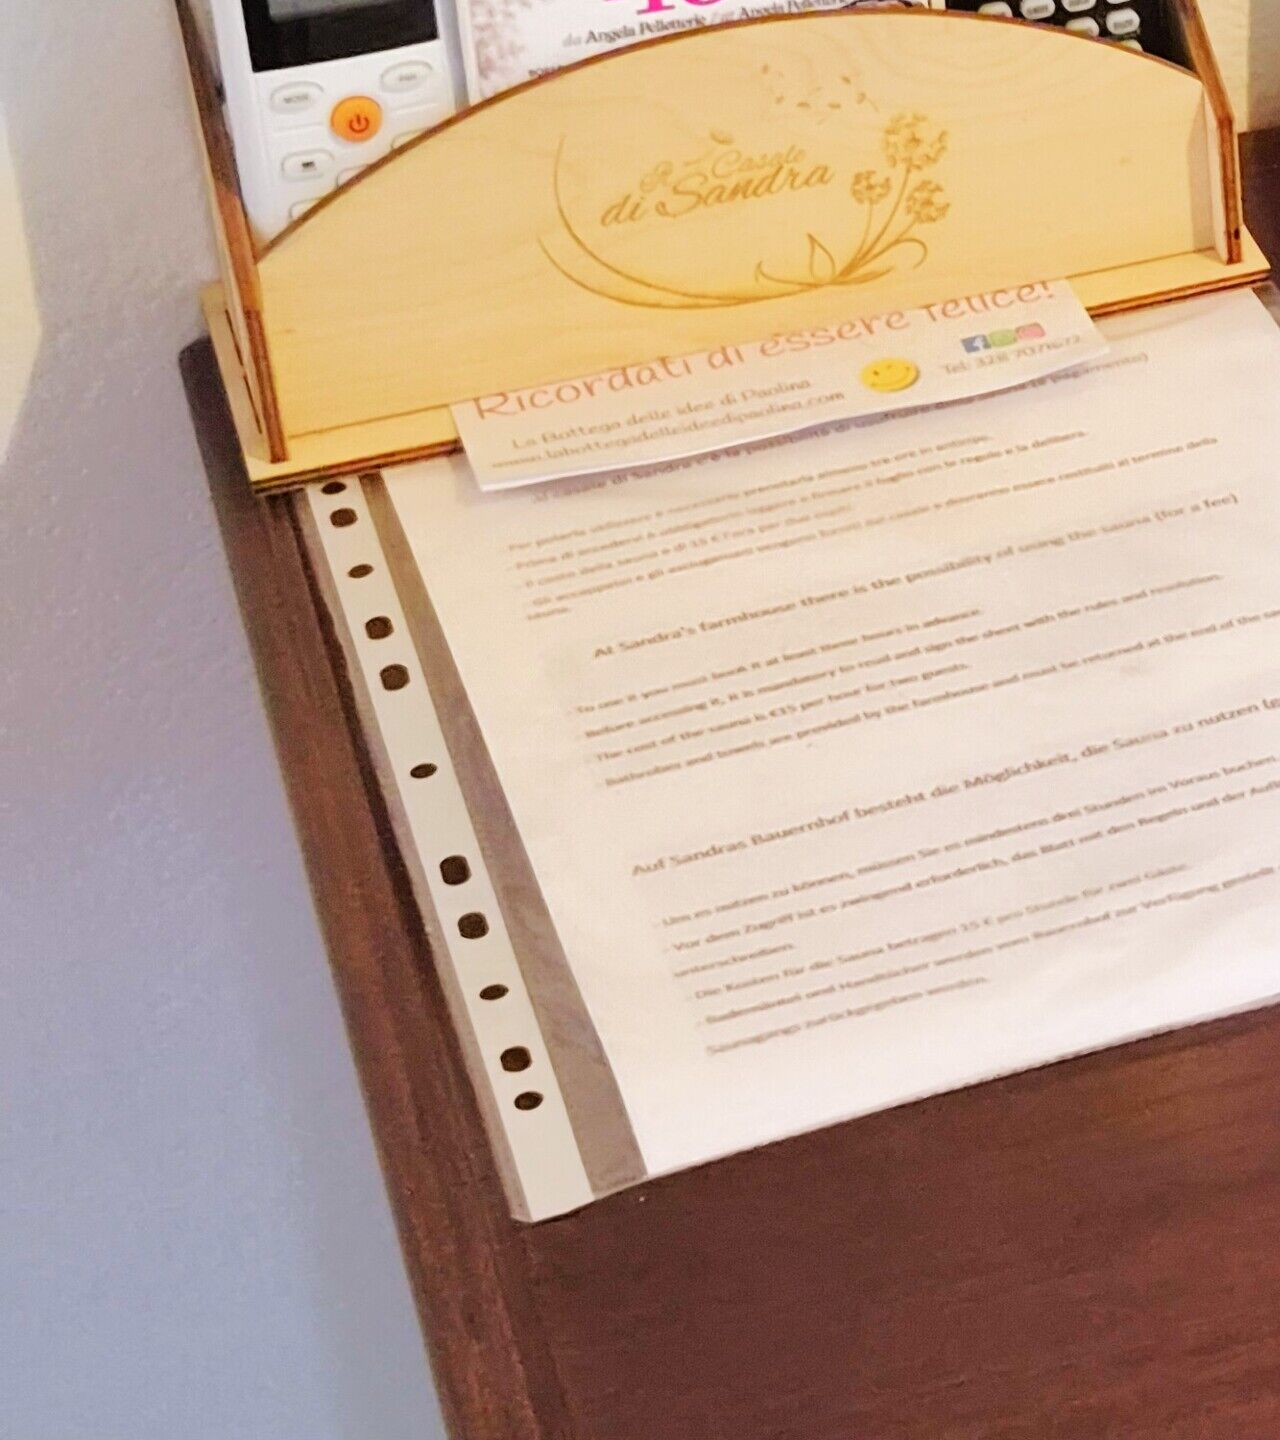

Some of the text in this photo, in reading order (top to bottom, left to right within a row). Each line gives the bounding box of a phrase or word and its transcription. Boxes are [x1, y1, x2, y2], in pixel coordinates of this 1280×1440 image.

[600, 193, 646, 227] di
[655, 164, 836, 218] Sandra
[473, 355, 692, 421] Ricordati
[707, 345, 745, 370] di
[759, 311, 909, 358] essere
